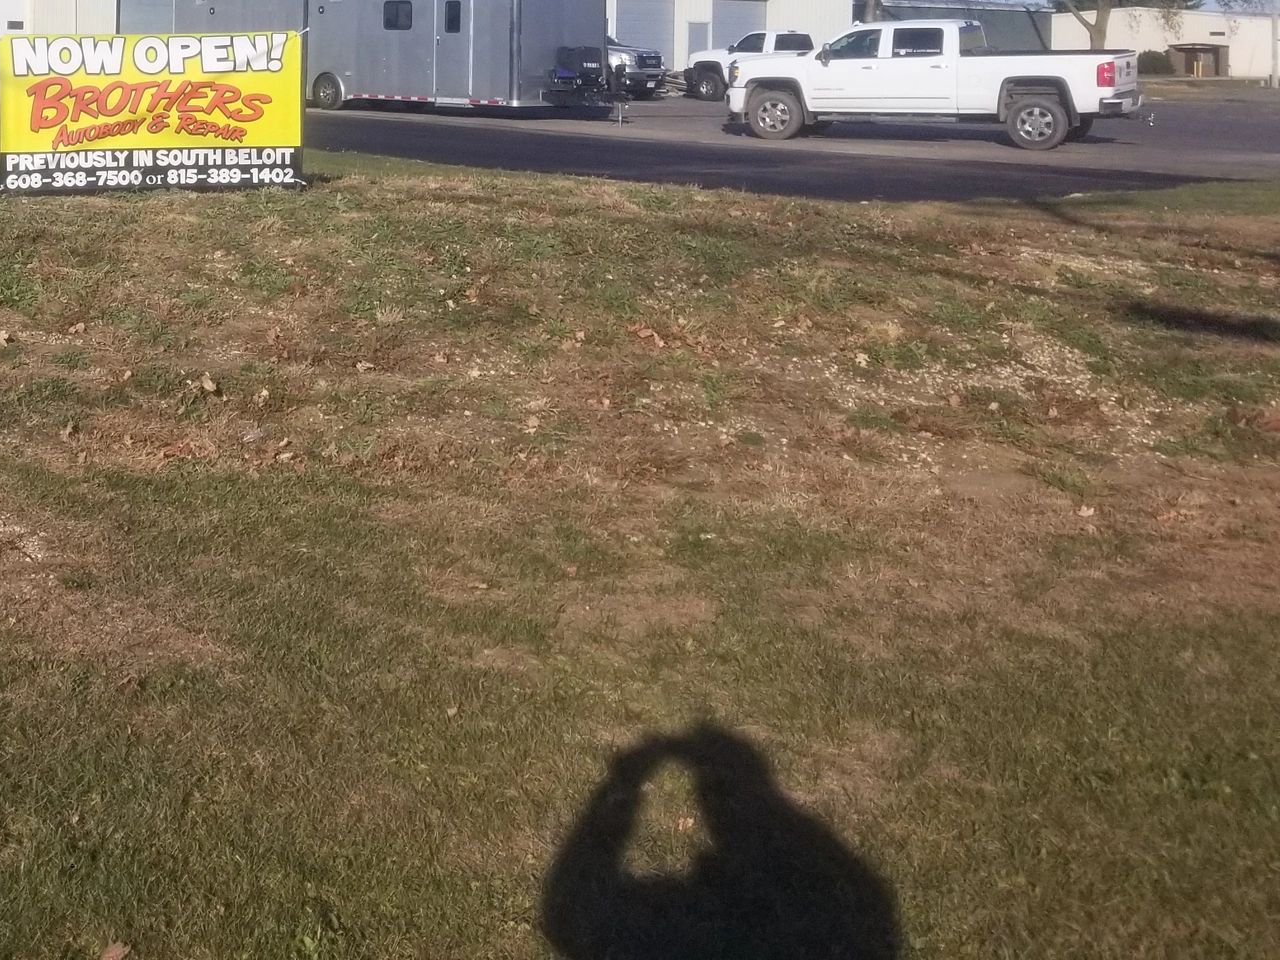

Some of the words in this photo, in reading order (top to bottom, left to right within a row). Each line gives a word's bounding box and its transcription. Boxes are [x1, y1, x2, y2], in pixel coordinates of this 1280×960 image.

[11, 36, 125, 76] NOW
[133, 32, 288, 75] OPEN!
[26, 76, 272, 132] BROTHERS
[52, 116, 146, 149] AUTOBODY
[147, 112, 170, 134] &
[176, 113, 248, 143] REPAIR
[6, 150, 129, 171] PREVIOUSLY
[133, 149, 153, 167] IN
[156, 148, 225, 166] SOUTH
[225, 147, 295, 165] BELOIT
[6, 170, 143, 189] 608-368-7500
[146, 174, 164, 185] or
[166, 167, 295, 185] 815-389-1402
